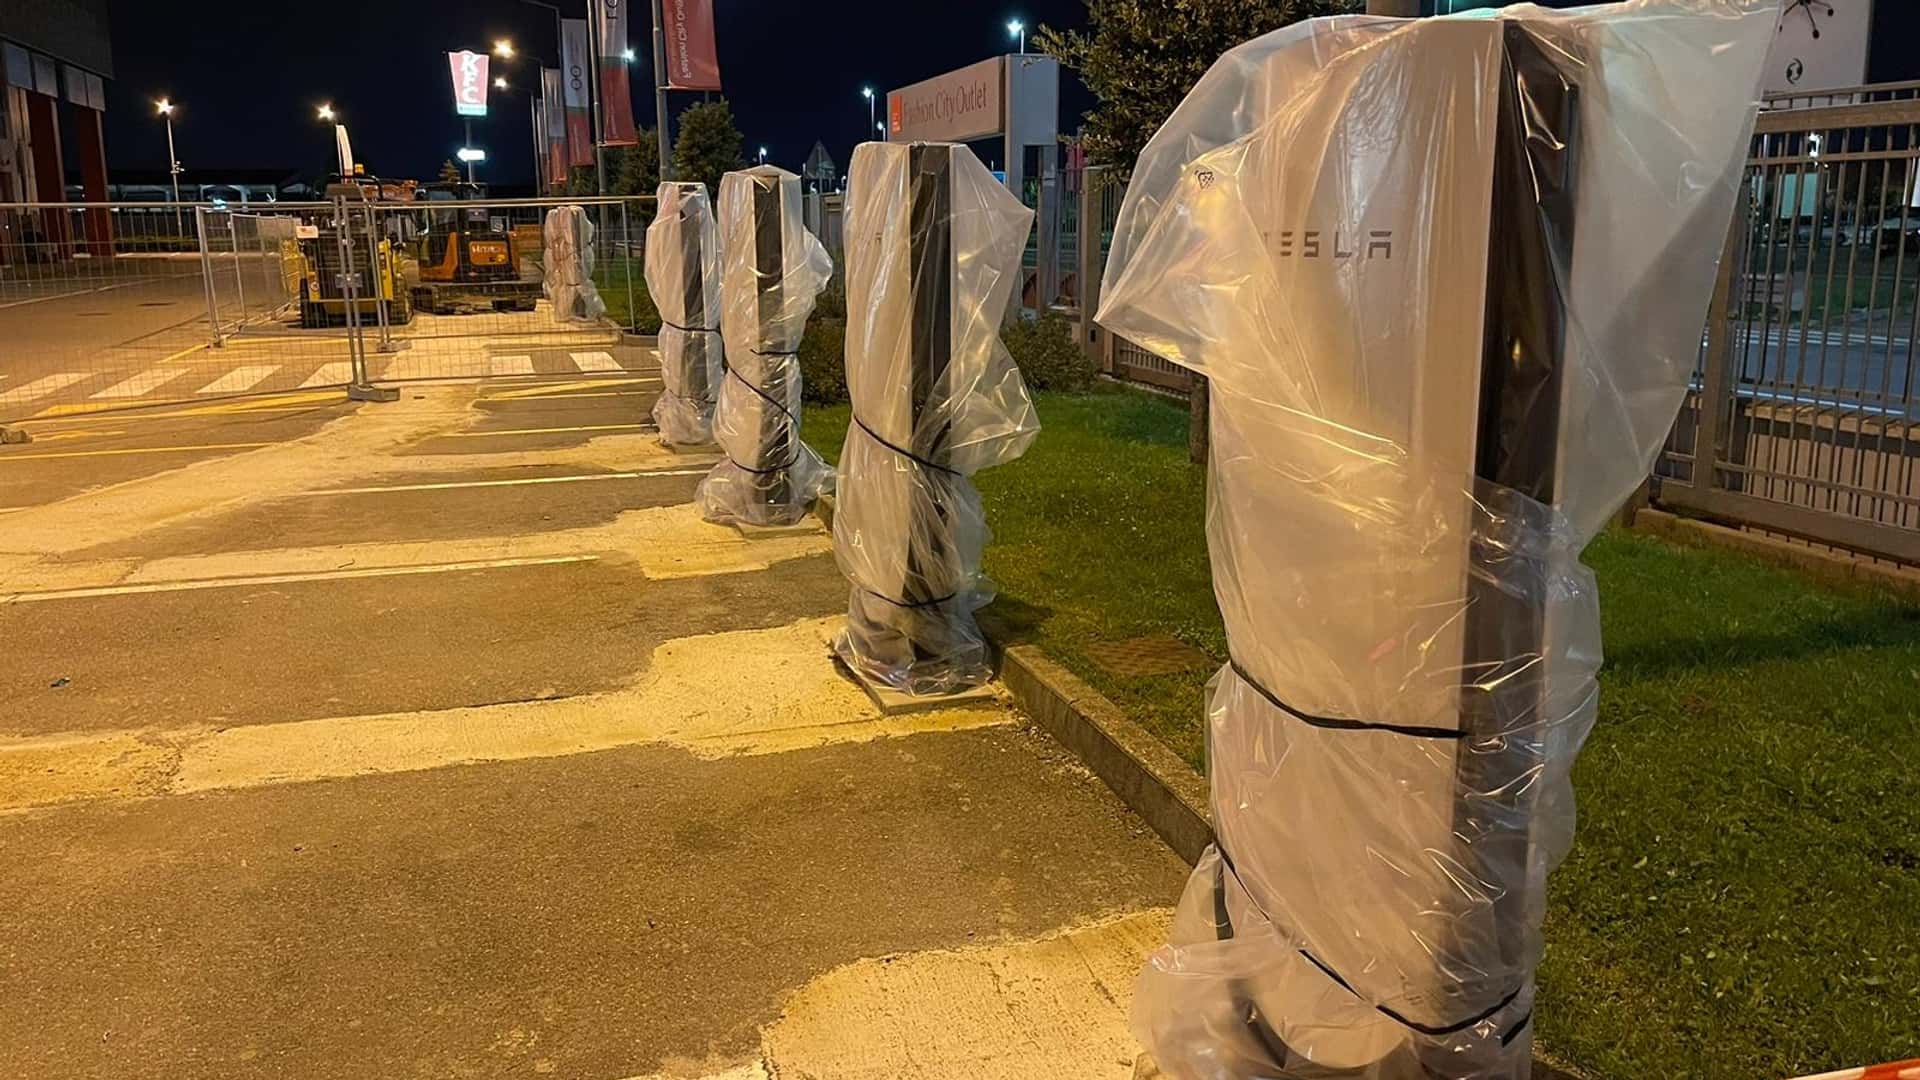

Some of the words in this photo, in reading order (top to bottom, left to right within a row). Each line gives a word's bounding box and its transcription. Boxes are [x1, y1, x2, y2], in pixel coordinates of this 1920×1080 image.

[461, 53, 484, 103] KFC
[936, 90, 954, 123] City
[957, 80, 987, 114] Outlet
